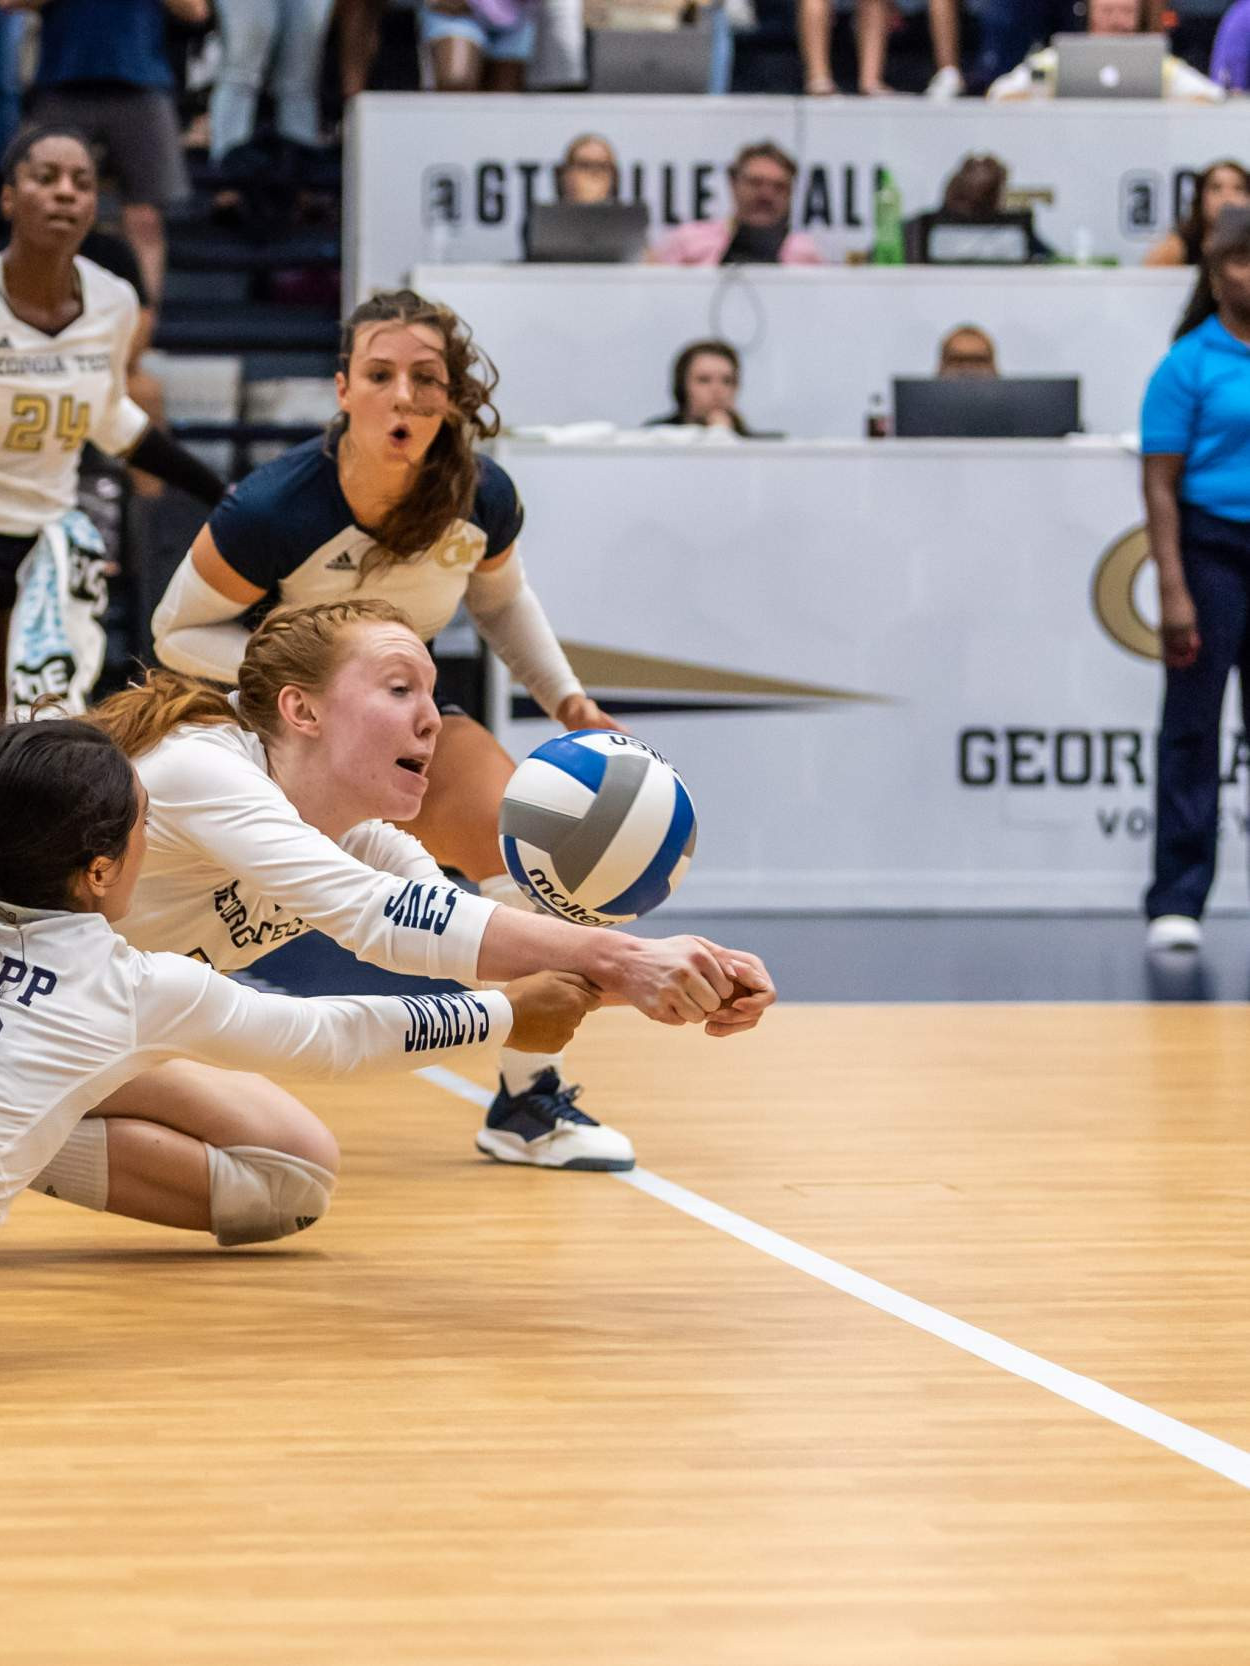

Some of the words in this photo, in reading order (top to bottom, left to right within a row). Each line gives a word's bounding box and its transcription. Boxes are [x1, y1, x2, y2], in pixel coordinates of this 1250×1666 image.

[4, 394, 90, 453] 24
[958, 726, 1250, 787] GEOR
[528, 867, 617, 929] molten
[251, 916, 313, 946] TEC
[398, 992, 491, 1053] JACKETS
